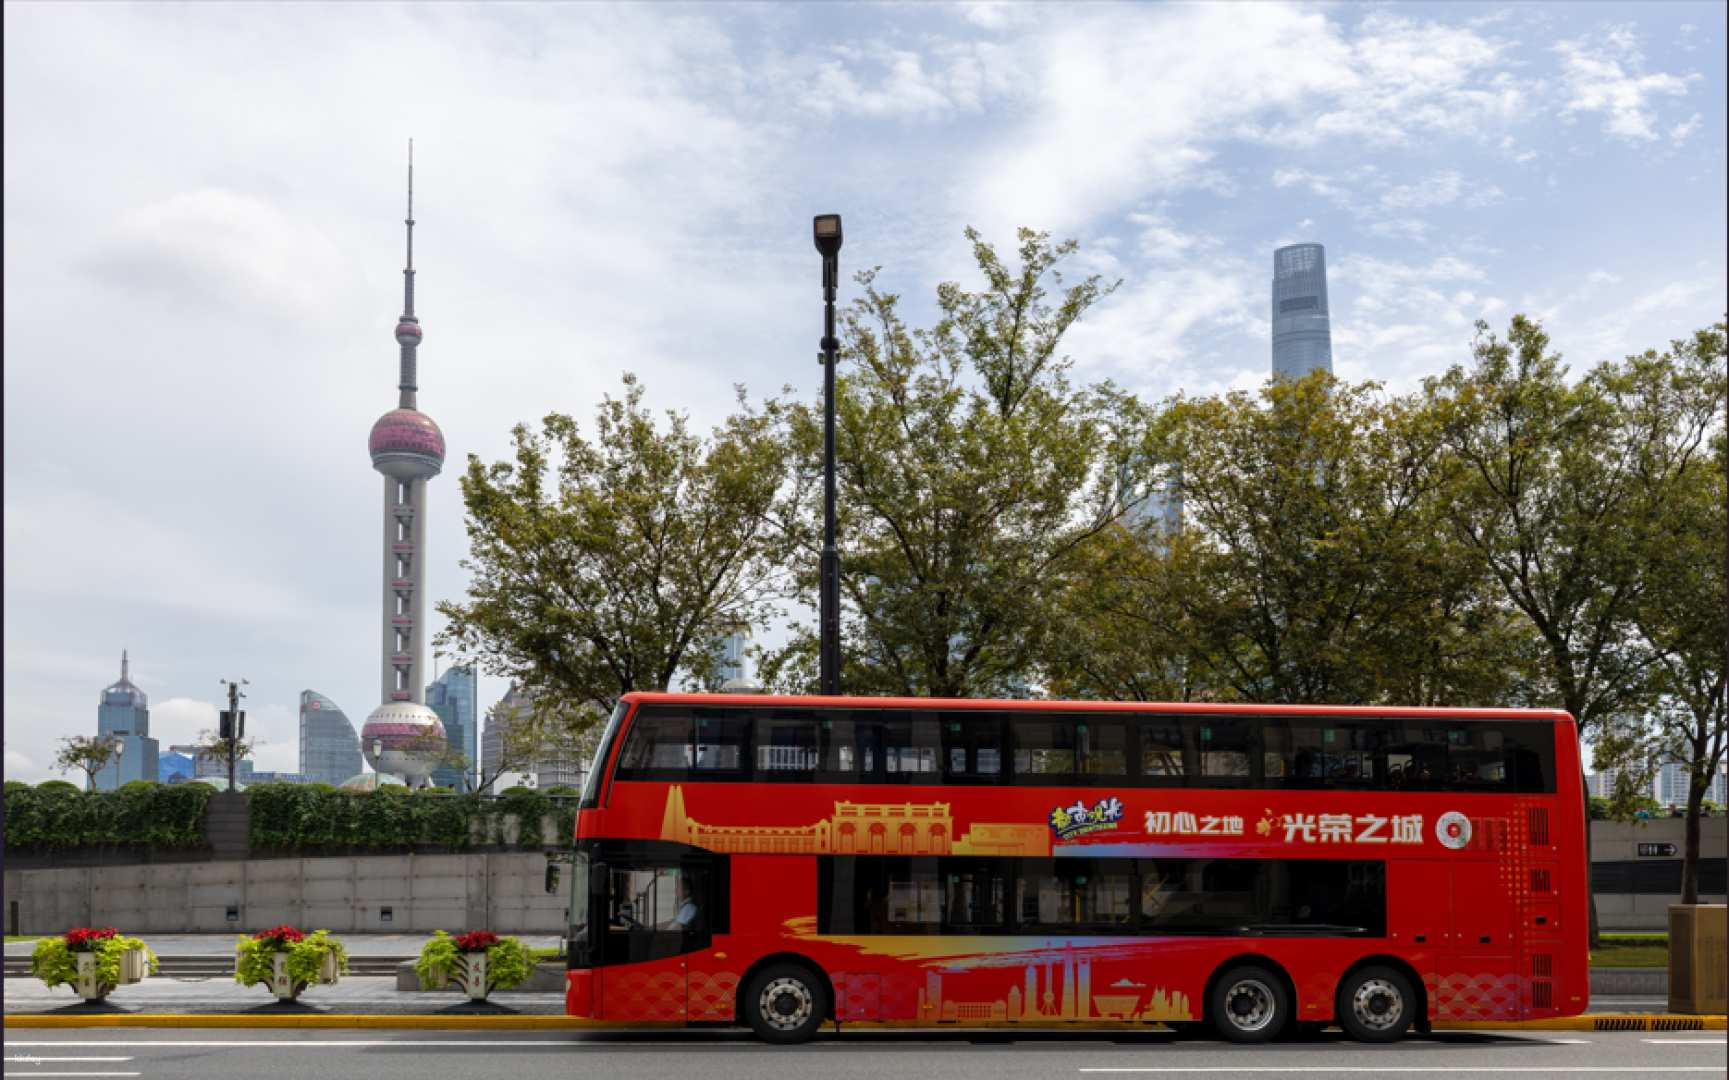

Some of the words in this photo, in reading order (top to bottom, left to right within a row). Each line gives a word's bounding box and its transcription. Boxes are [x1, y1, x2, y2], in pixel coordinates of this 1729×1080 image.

[1145, 811, 1244, 835] 初心之地
[1283, 813, 1423, 844] 光荣之城
